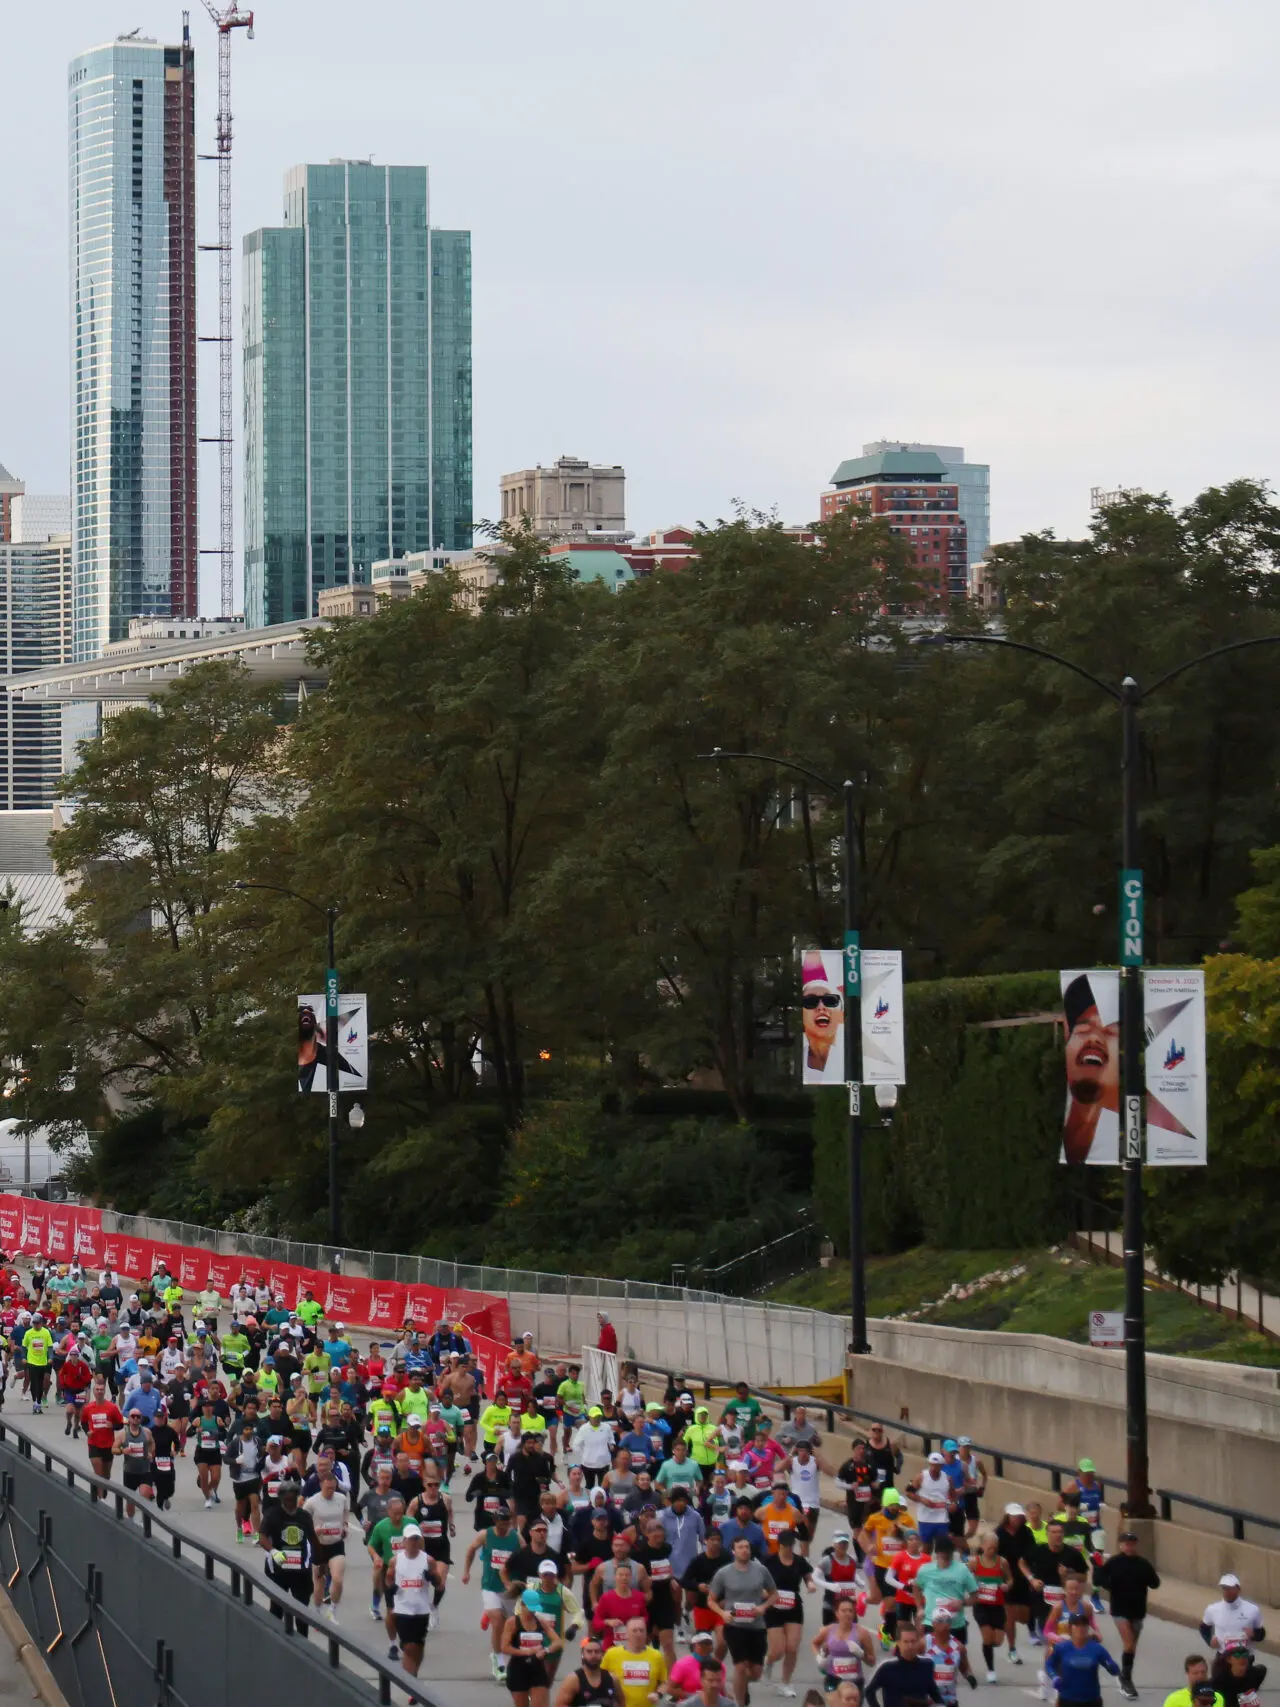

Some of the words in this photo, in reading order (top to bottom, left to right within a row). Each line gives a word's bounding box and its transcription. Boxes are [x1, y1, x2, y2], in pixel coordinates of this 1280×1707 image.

[1123, 879, 1142, 956] C10N
[846, 944, 858, 983] C10
[328, 978, 337, 1007] C20
[1128, 1098, 1140, 1155] C10N
